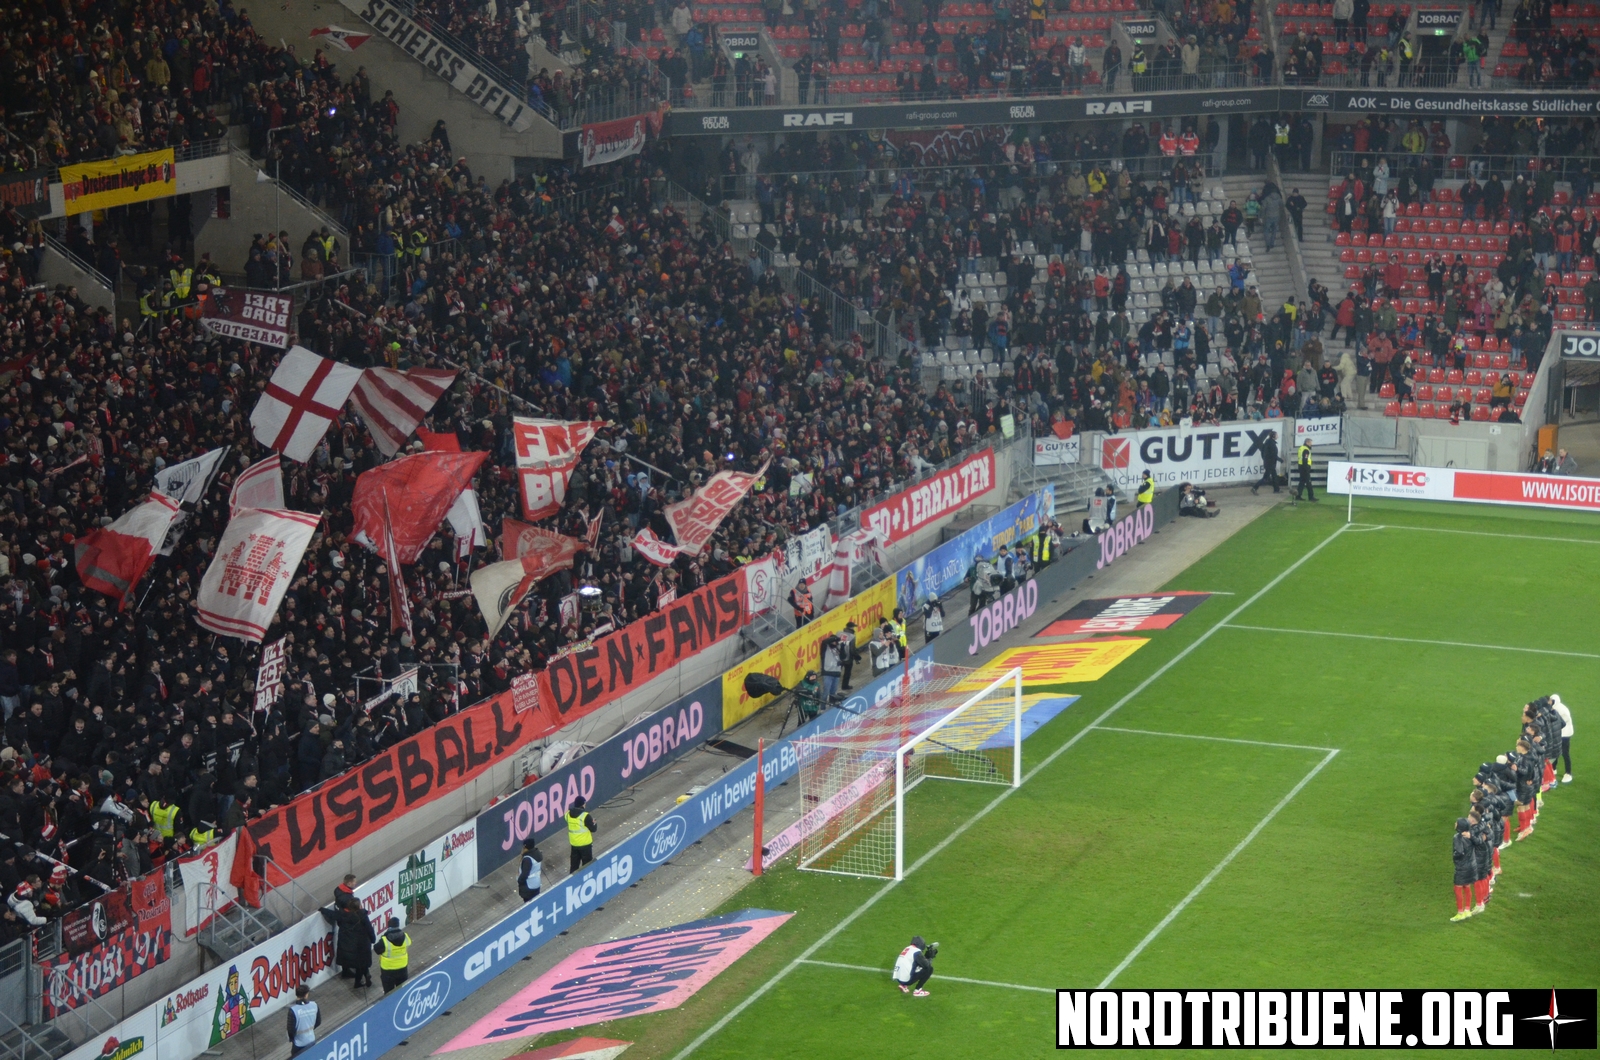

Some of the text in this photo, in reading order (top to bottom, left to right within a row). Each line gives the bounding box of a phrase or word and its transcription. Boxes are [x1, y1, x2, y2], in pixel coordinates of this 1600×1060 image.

[360, 0, 465, 83] SCHEISS
[724, 37, 758, 47] OBRAD
[1126, 25, 1155, 34] OBRAD
[1010, 110, 1035, 118] TOUCH
[1086, 100, 1152, 115] RAFI
[1202, 98, 1251, 108] rafi-group.com
[1307, 95, 1329, 105] AOK
[1348, 97, 1377, 109] AOK
[1391, 98, 1411, 109] Die
[1415, 99, 1528, 111] Gesundheitskasse
[1532, 99, 1592, 112] Südlicher
[784, 112, 853, 127] RAFI
[906, 111, 958, 121] rafi-group.com
[1564, 337, 1600, 356] JO
[1306, 423, 1338, 432] GUTEX
[1045, 442, 1078, 451] GUTEX
[1140, 429, 1273, 465] GUTEX
[911, 456, 989, 526] ERHALTEN
[1113, 465, 1266, 486] ACHHLTIG MIT JEDER FASE
[1353, 484, 1364, 492] Wir
[1096, 504, 1154, 570] JOBRAD
[857, 602, 883, 632] LOTTO
[969, 579, 1038, 655] JOBRAD
[806, 631, 833, 664] LOT
[251, 579, 740, 864] FUSSBALL DEN FANS
[620, 701, 704, 779] JOBRAD
[700, 788, 722, 824] Wir
[724, 756, 778, 805] beween
[502, 765, 595, 851] JOBRAD
[650, 821, 682, 859] Ford
[464, 907, 543, 981] ernst
[565, 854, 633, 916] könig
[250, 932, 335, 1008] Rothaus
[175, 983, 209, 1014] Rothaus
[404, 979, 441, 1026] Ford
[326, 1022, 368, 1060] den!
